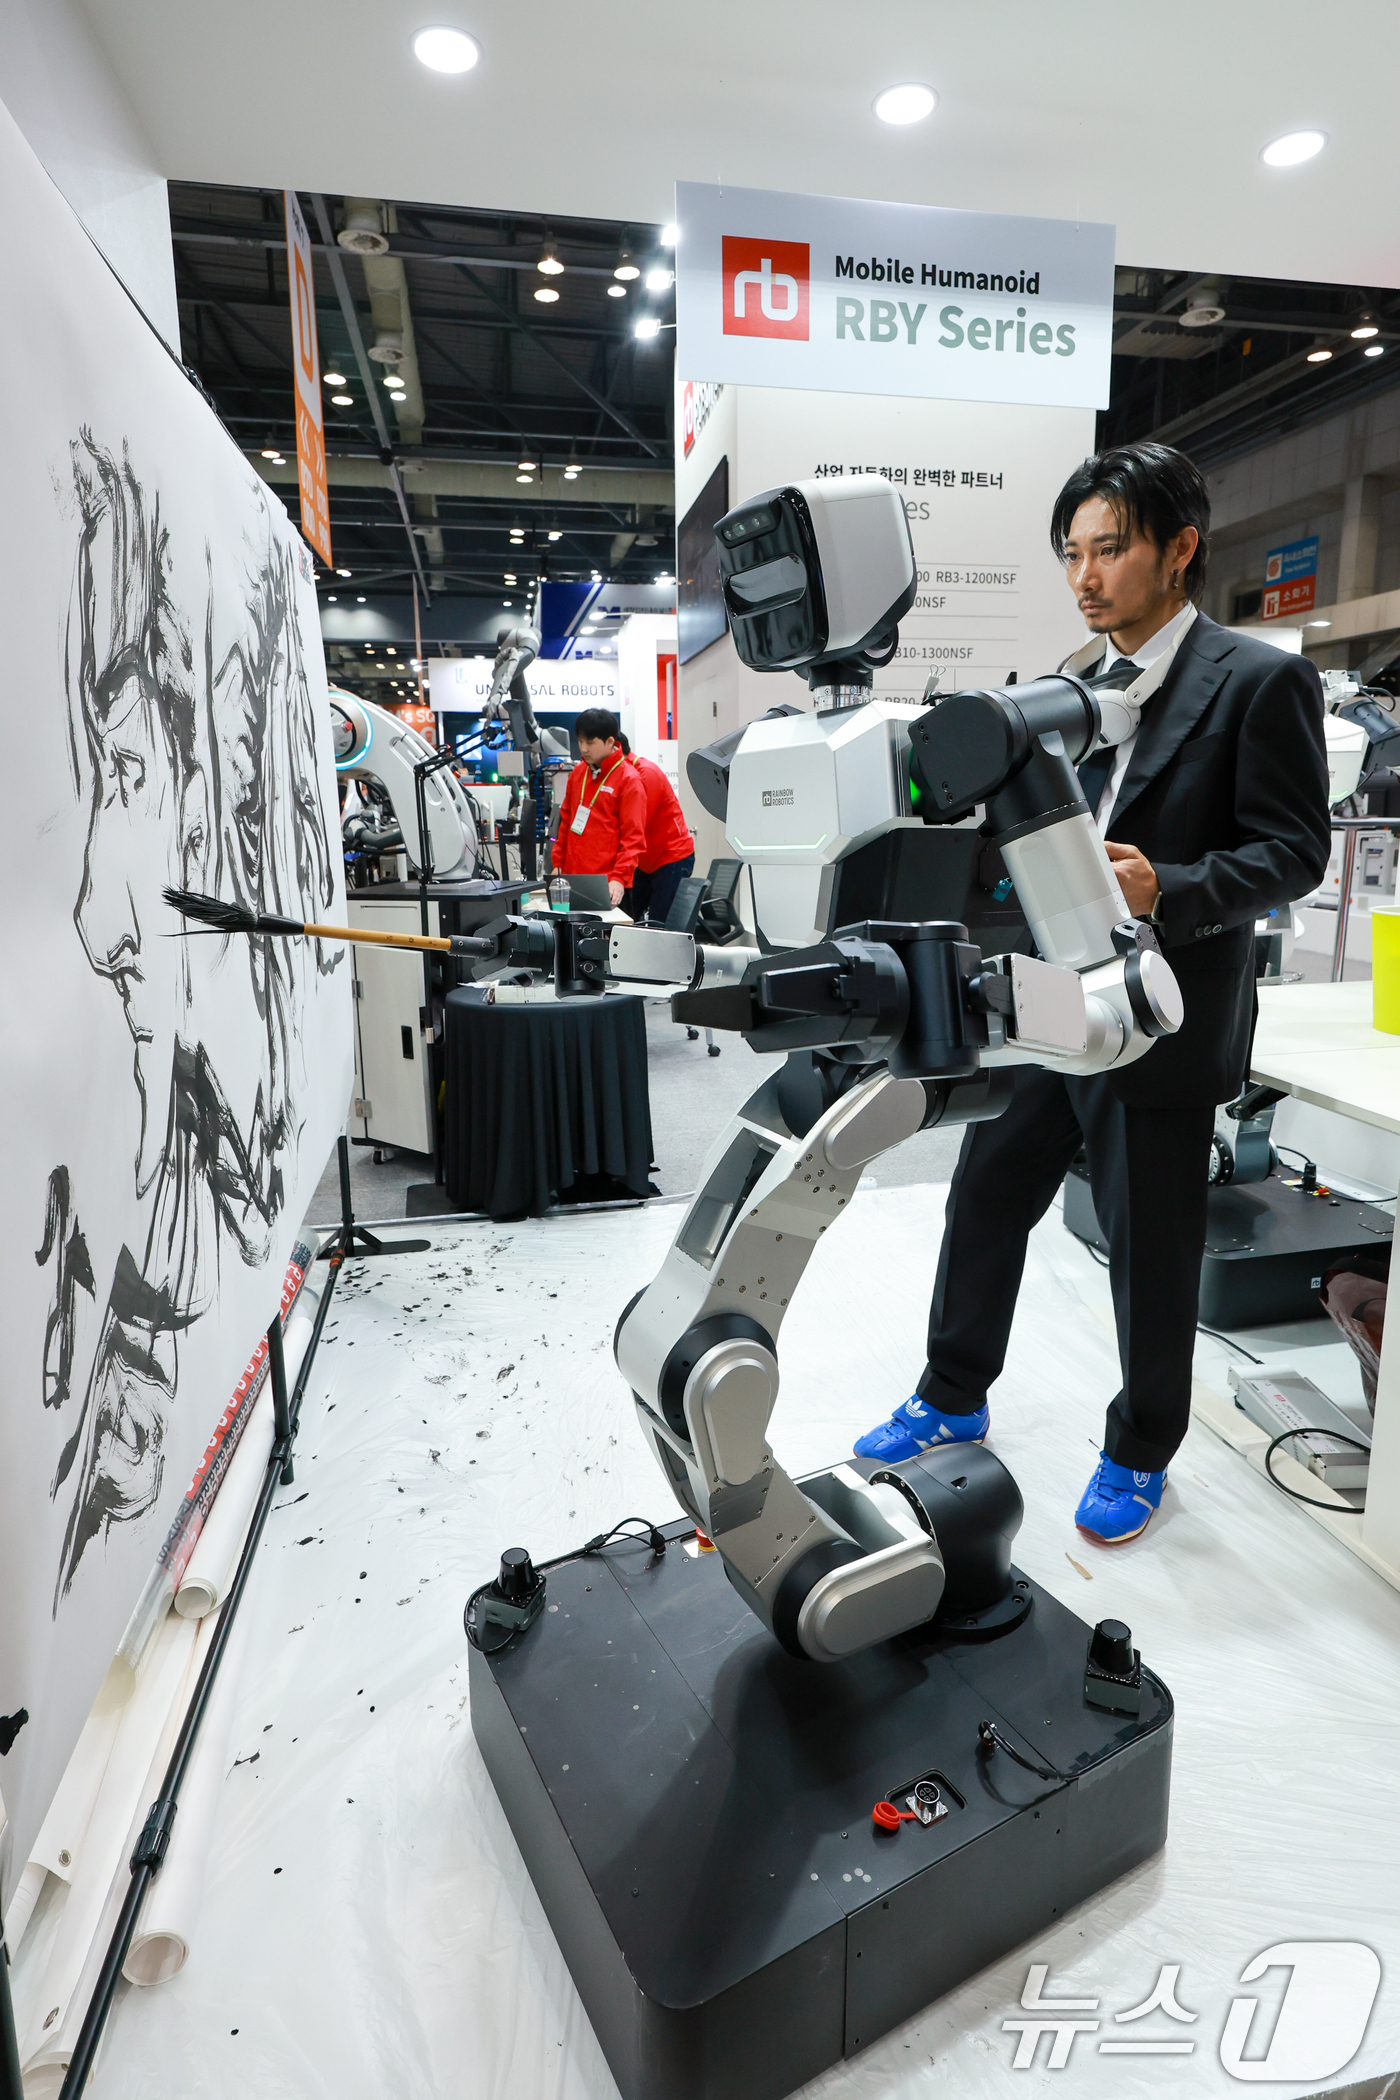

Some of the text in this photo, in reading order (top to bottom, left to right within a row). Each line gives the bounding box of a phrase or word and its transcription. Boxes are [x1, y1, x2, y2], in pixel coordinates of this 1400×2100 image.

[835, 255, 1041, 295] Mobile Humanoid
[835, 296, 1077, 358] RBY Series
[913, 468, 957, 487] 완벽한
[961, 470, 1004, 490] 파트너
[936, 571, 1017, 585] RB3-1200NSF
[894, 646, 974, 659] B10-1300NSF
[475, 684, 615, 697] UNSAL ROBOTS
[772, 789, 793, 797] RAINBOW
[772, 797, 794, 805] ROBOTICS
